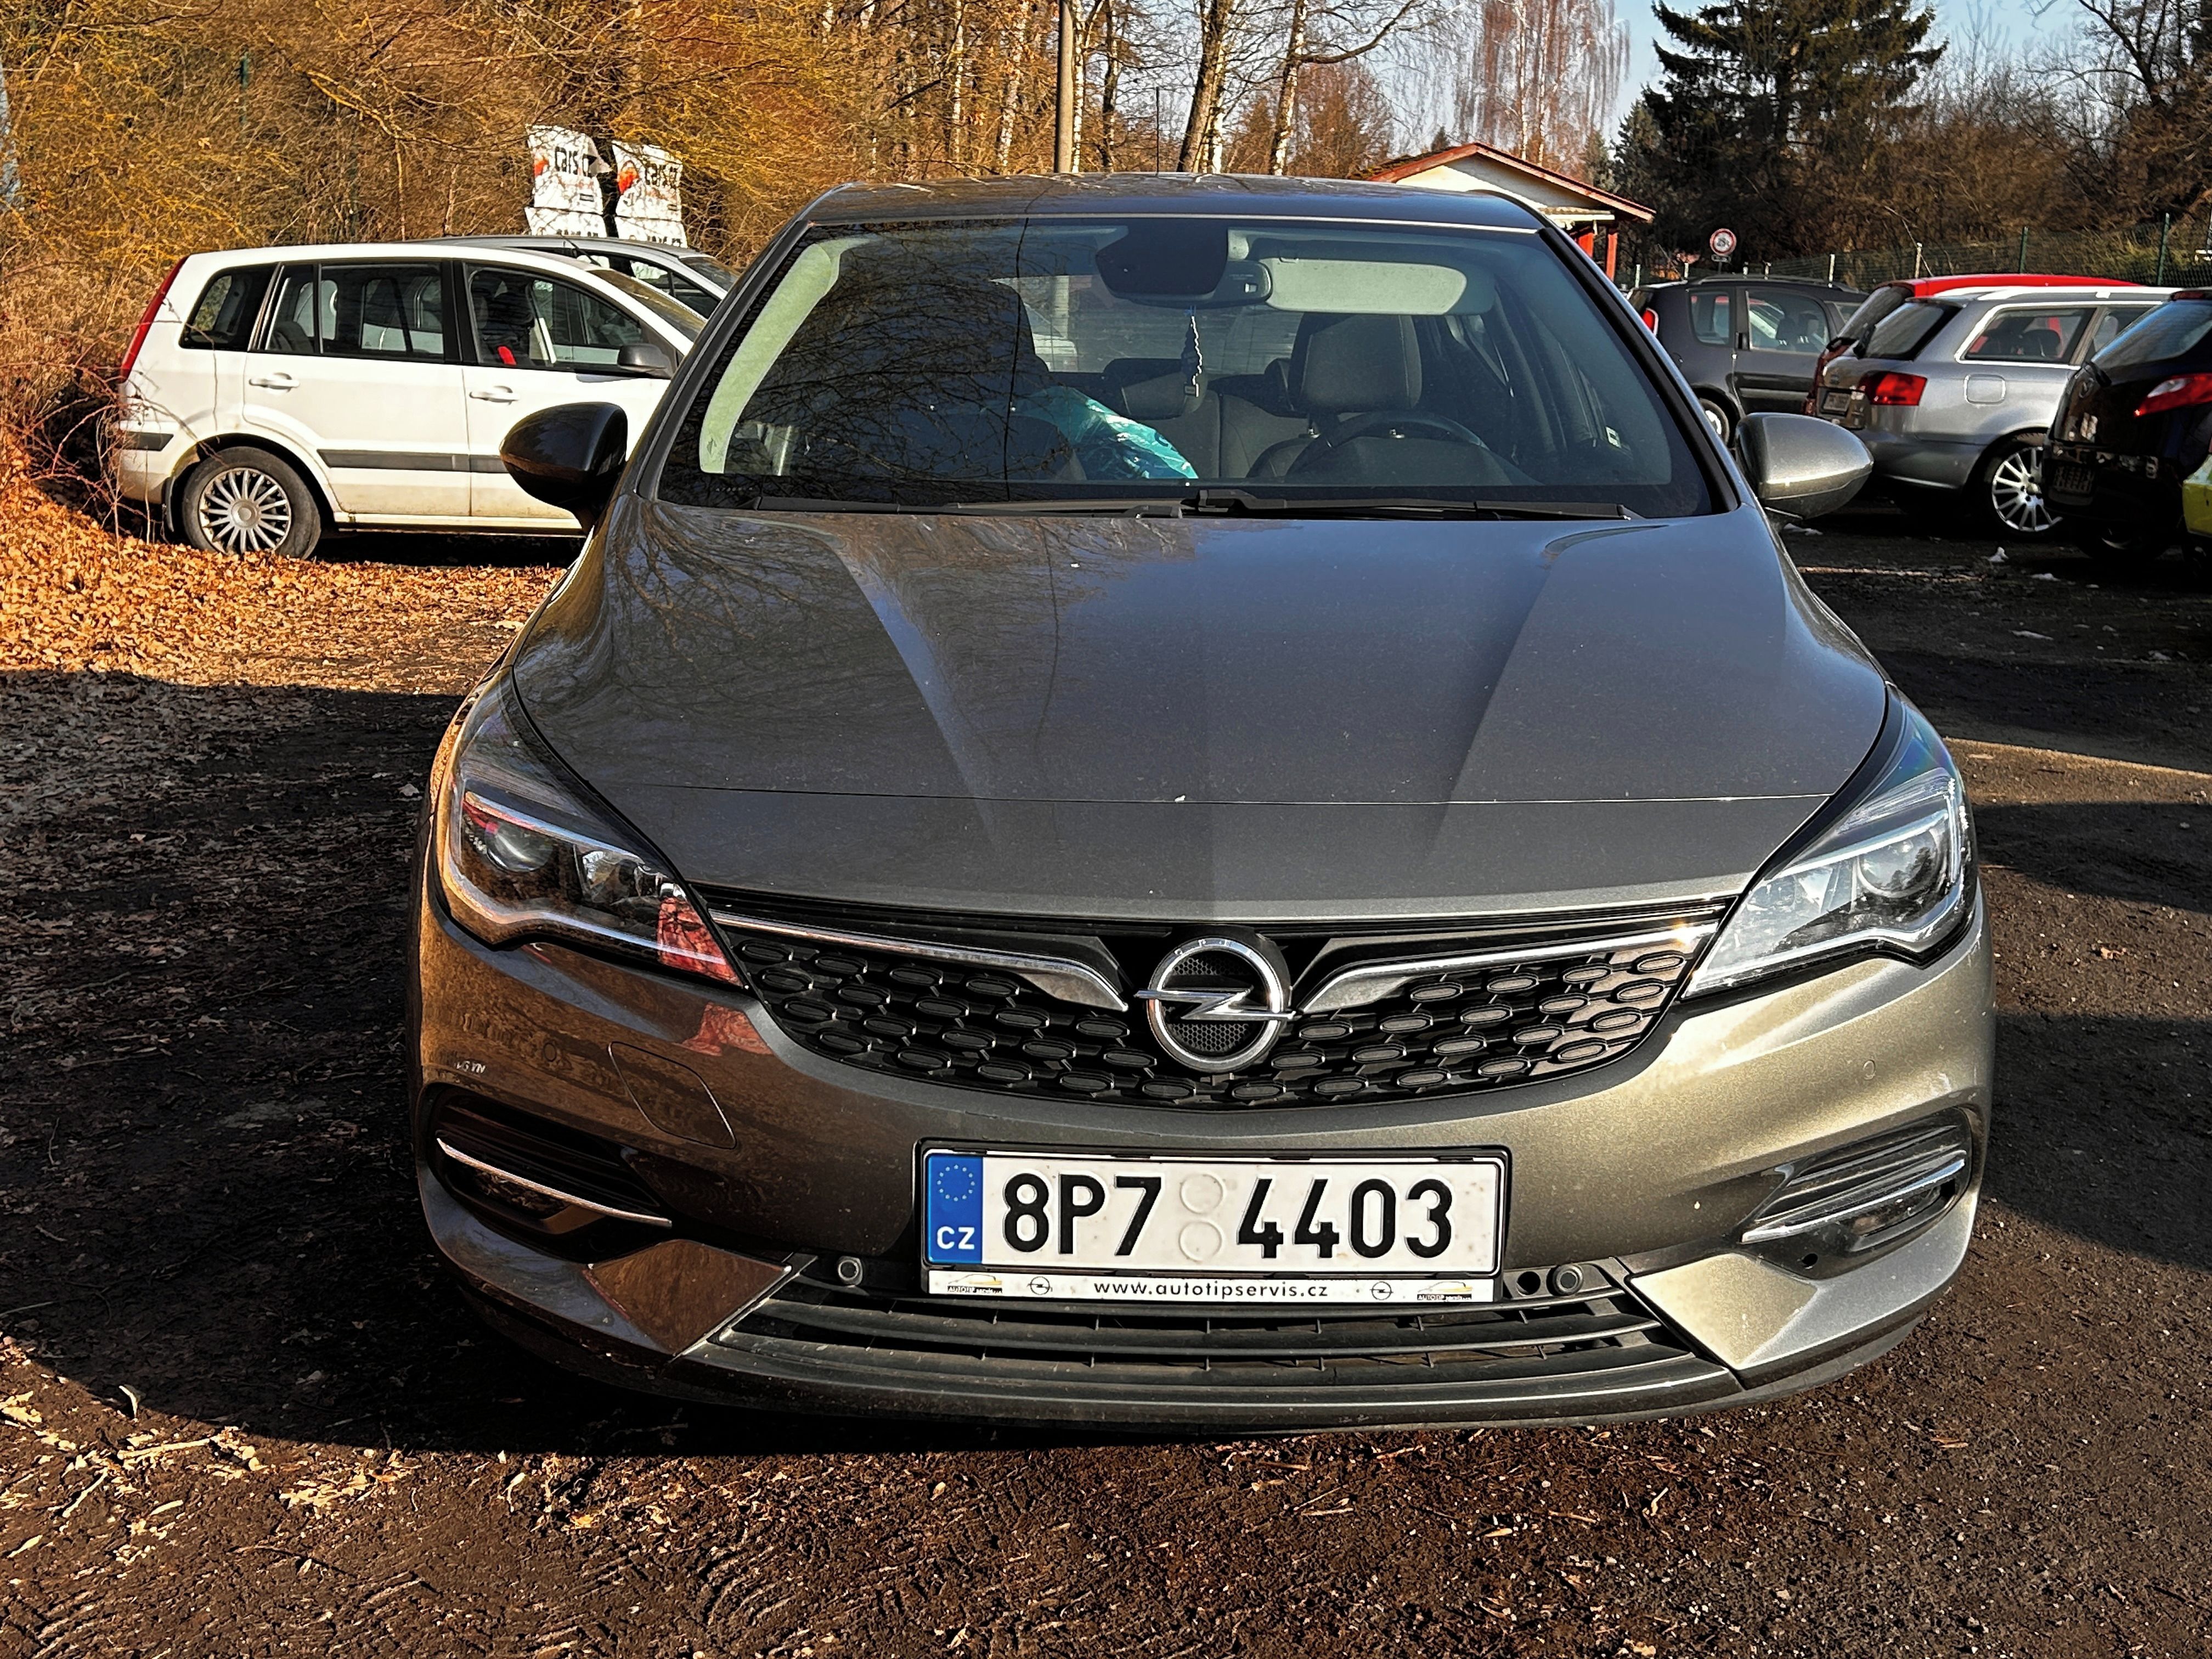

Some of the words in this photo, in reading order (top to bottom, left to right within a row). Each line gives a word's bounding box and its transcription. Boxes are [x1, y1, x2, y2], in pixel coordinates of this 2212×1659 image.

[1003, 1172, 1163, 1256] 8P7
[1237, 1178, 1453, 1259] 4403
[936, 1226, 975, 1250] CZ
[1094, 1280, 1328, 1299] www.autotipservis.cz
